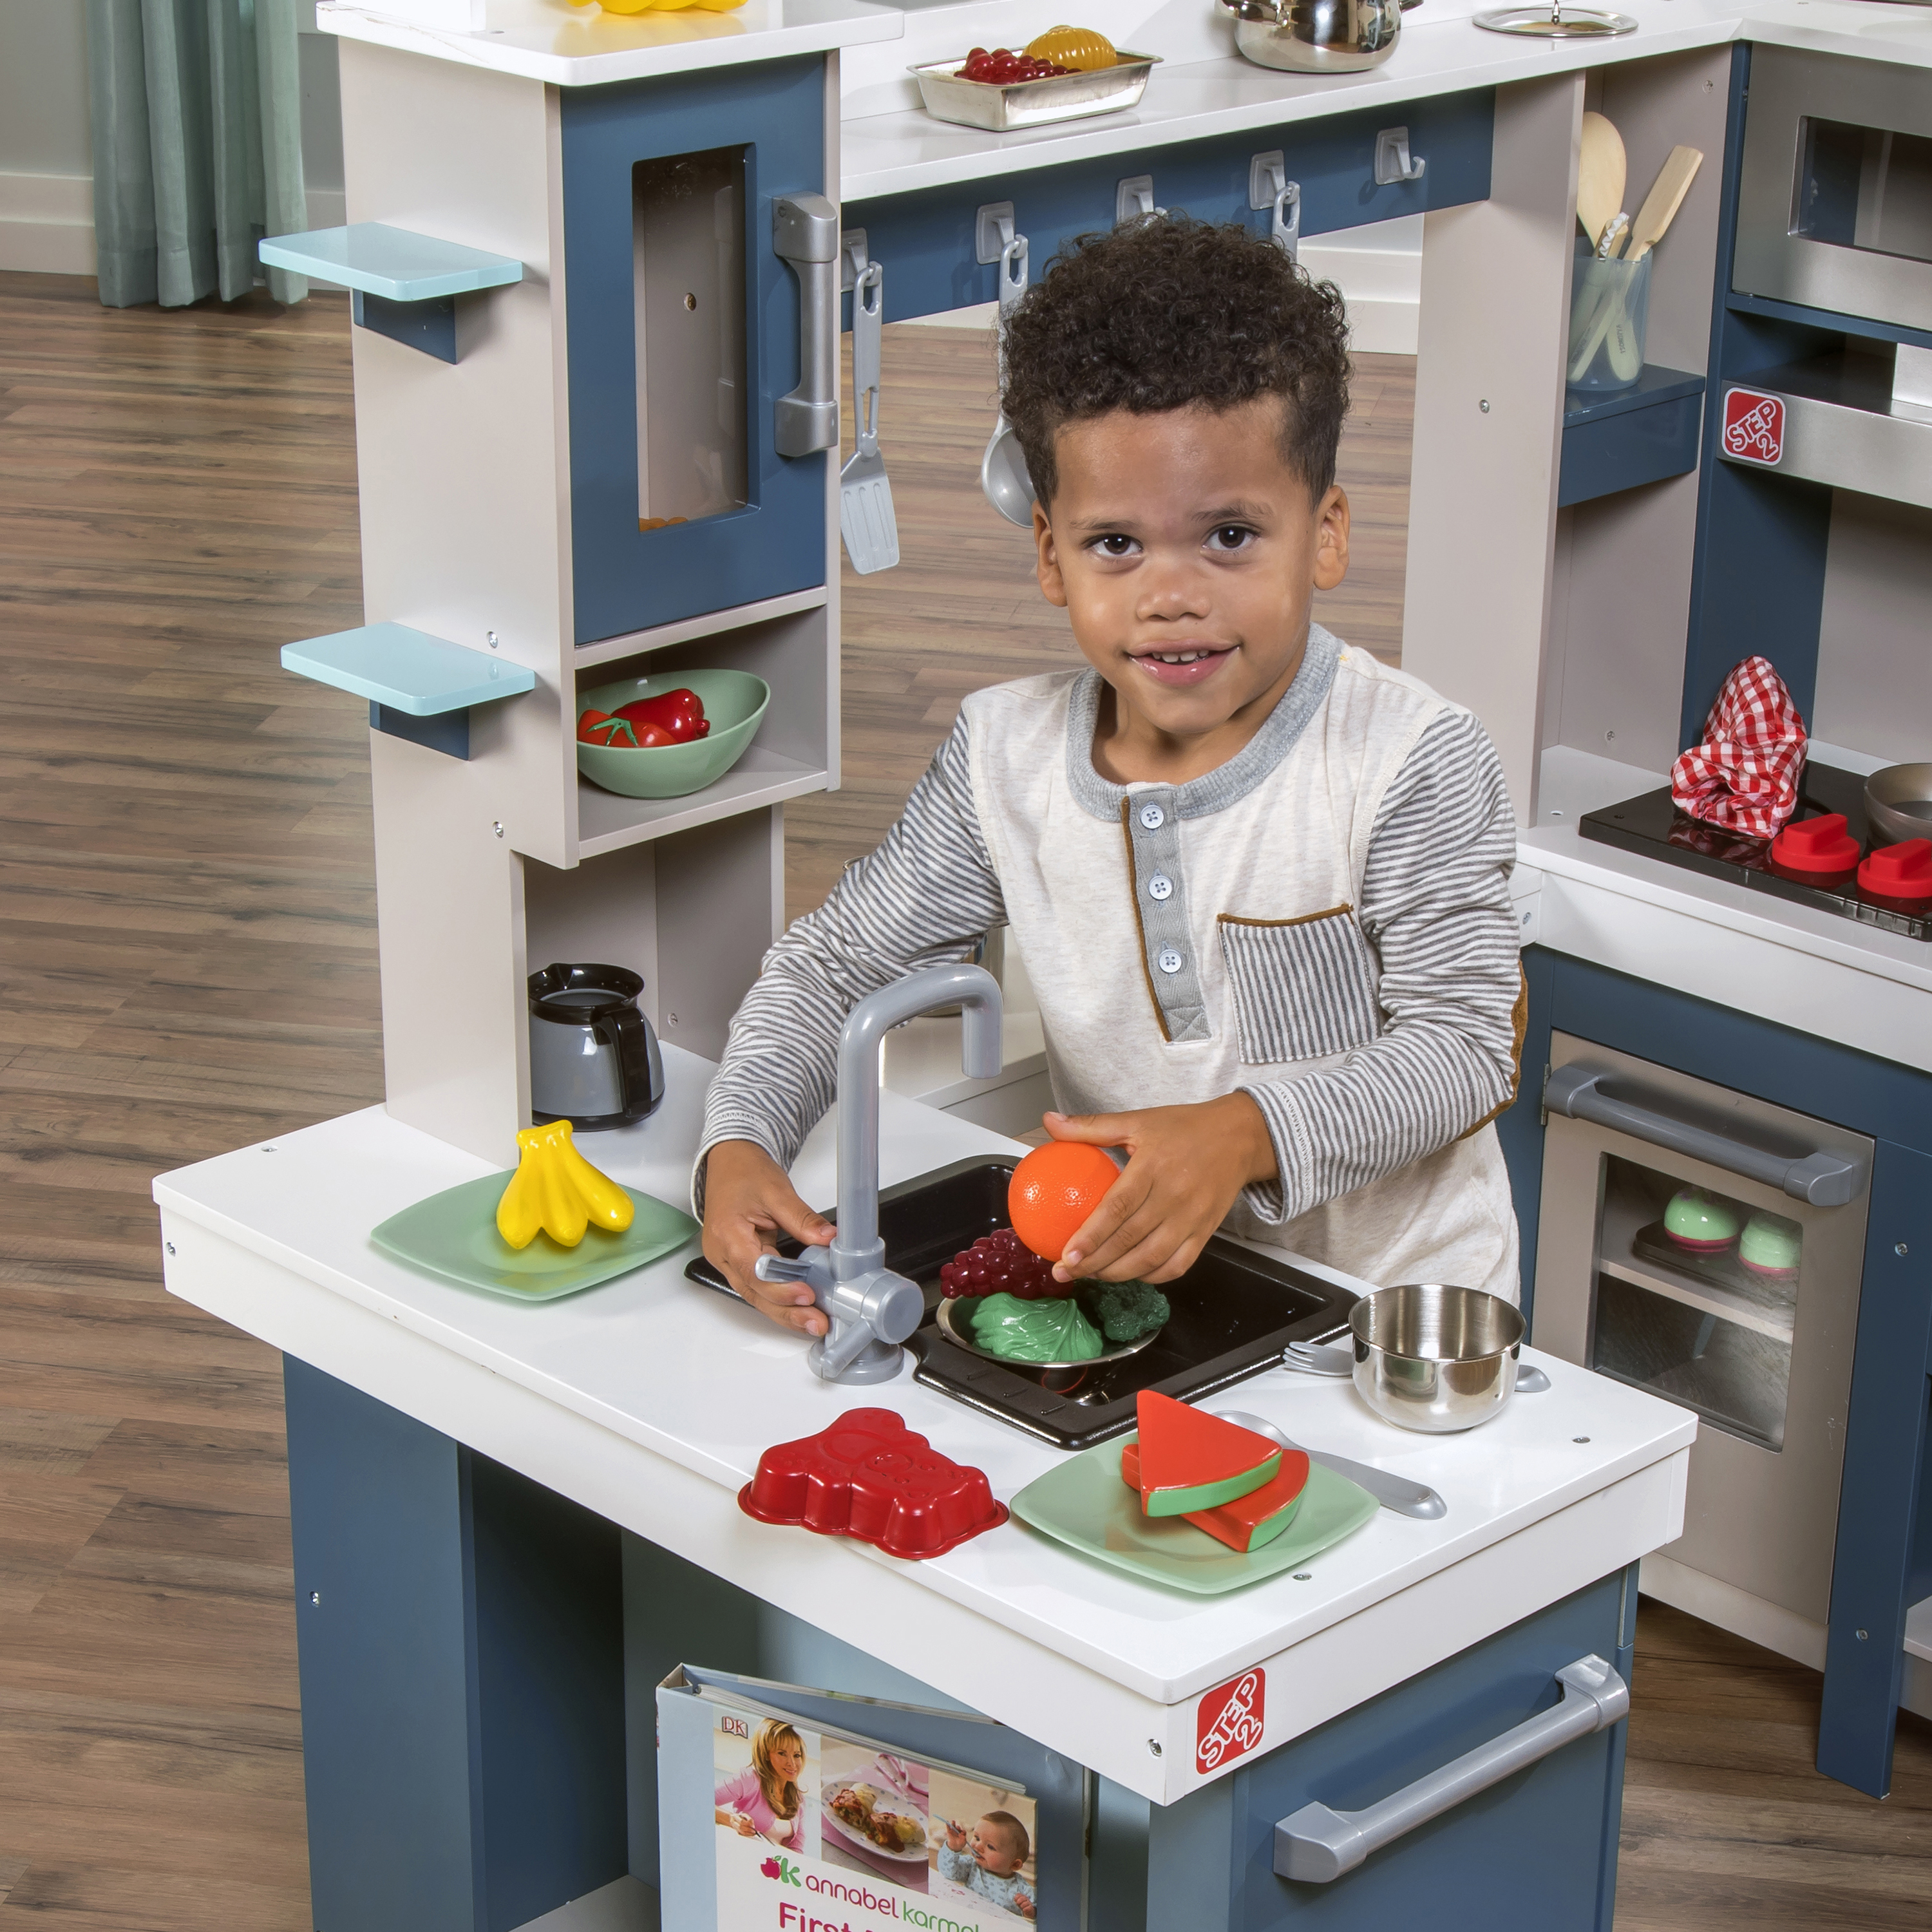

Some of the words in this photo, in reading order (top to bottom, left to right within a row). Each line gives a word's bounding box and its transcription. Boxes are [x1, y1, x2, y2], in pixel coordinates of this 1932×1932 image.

[1727, 399, 1776, 451] STEP
[1756, 431, 1779, 459] 2
[724, 1716, 746, 1736] DK
[1198, 1672, 1258, 1768] STEP
[1235, 1715, 1262, 1750] 2
[805, 1875, 899, 1919] annabel
